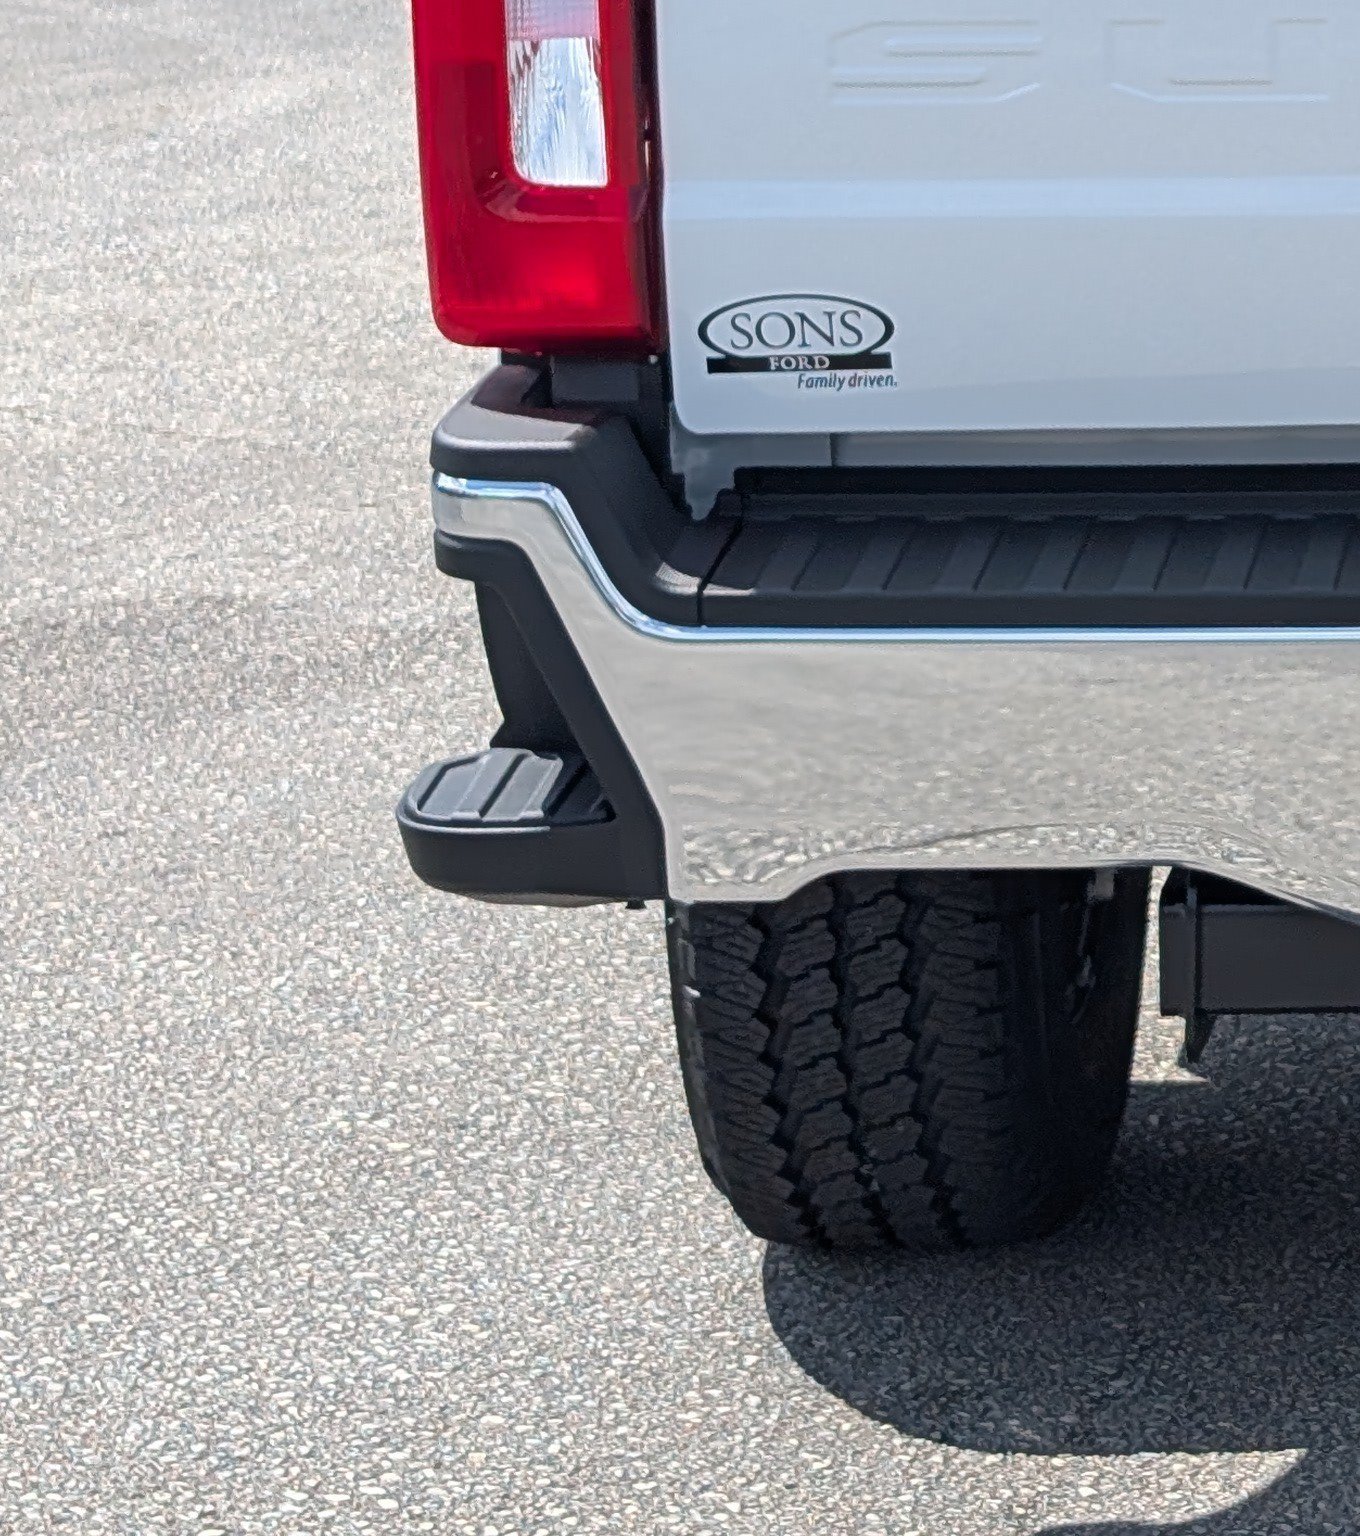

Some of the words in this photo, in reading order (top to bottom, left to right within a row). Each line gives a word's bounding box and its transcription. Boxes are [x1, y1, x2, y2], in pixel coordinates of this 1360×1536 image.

[730, 310, 864, 350] SONS
[769, 354, 831, 370] FORD
[797, 373, 846, 391] Family
